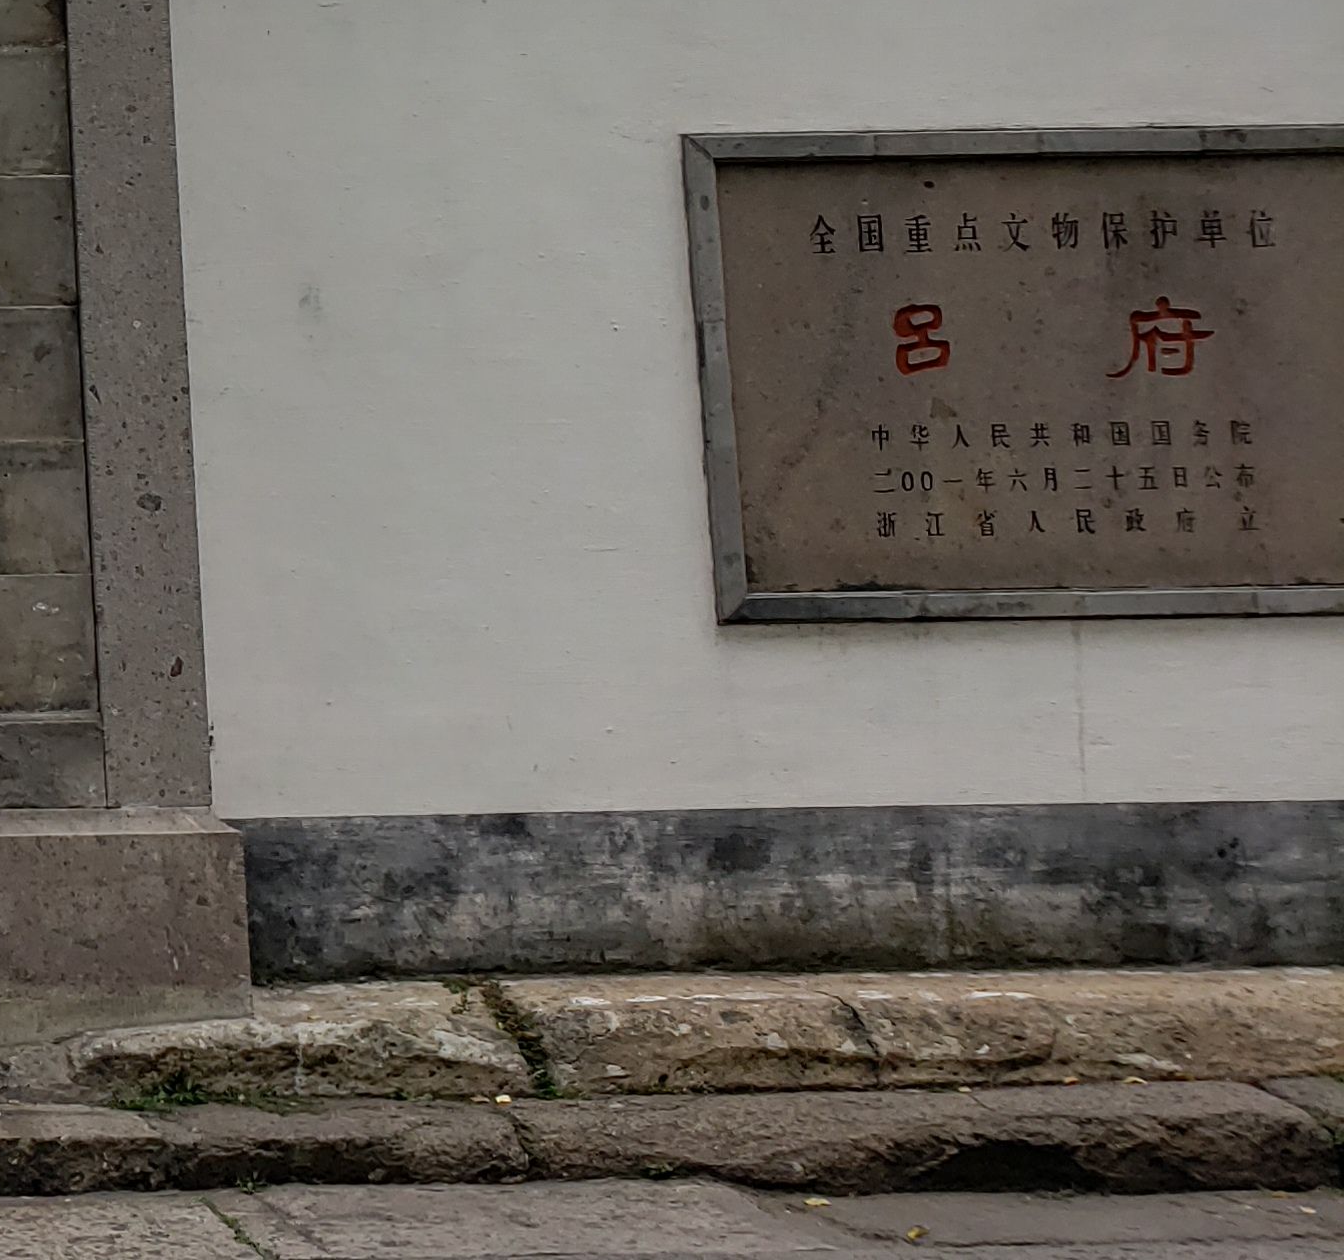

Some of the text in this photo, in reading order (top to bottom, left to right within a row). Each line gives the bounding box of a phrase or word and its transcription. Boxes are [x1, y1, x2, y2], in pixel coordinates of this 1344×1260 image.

[810, 211, 1275, 254] 全国重点文物保护单位
[872, 420, 1254, 451] 中华人民共和国国务院
[877, 507, 1260, 537] 浙江省人民政府立
